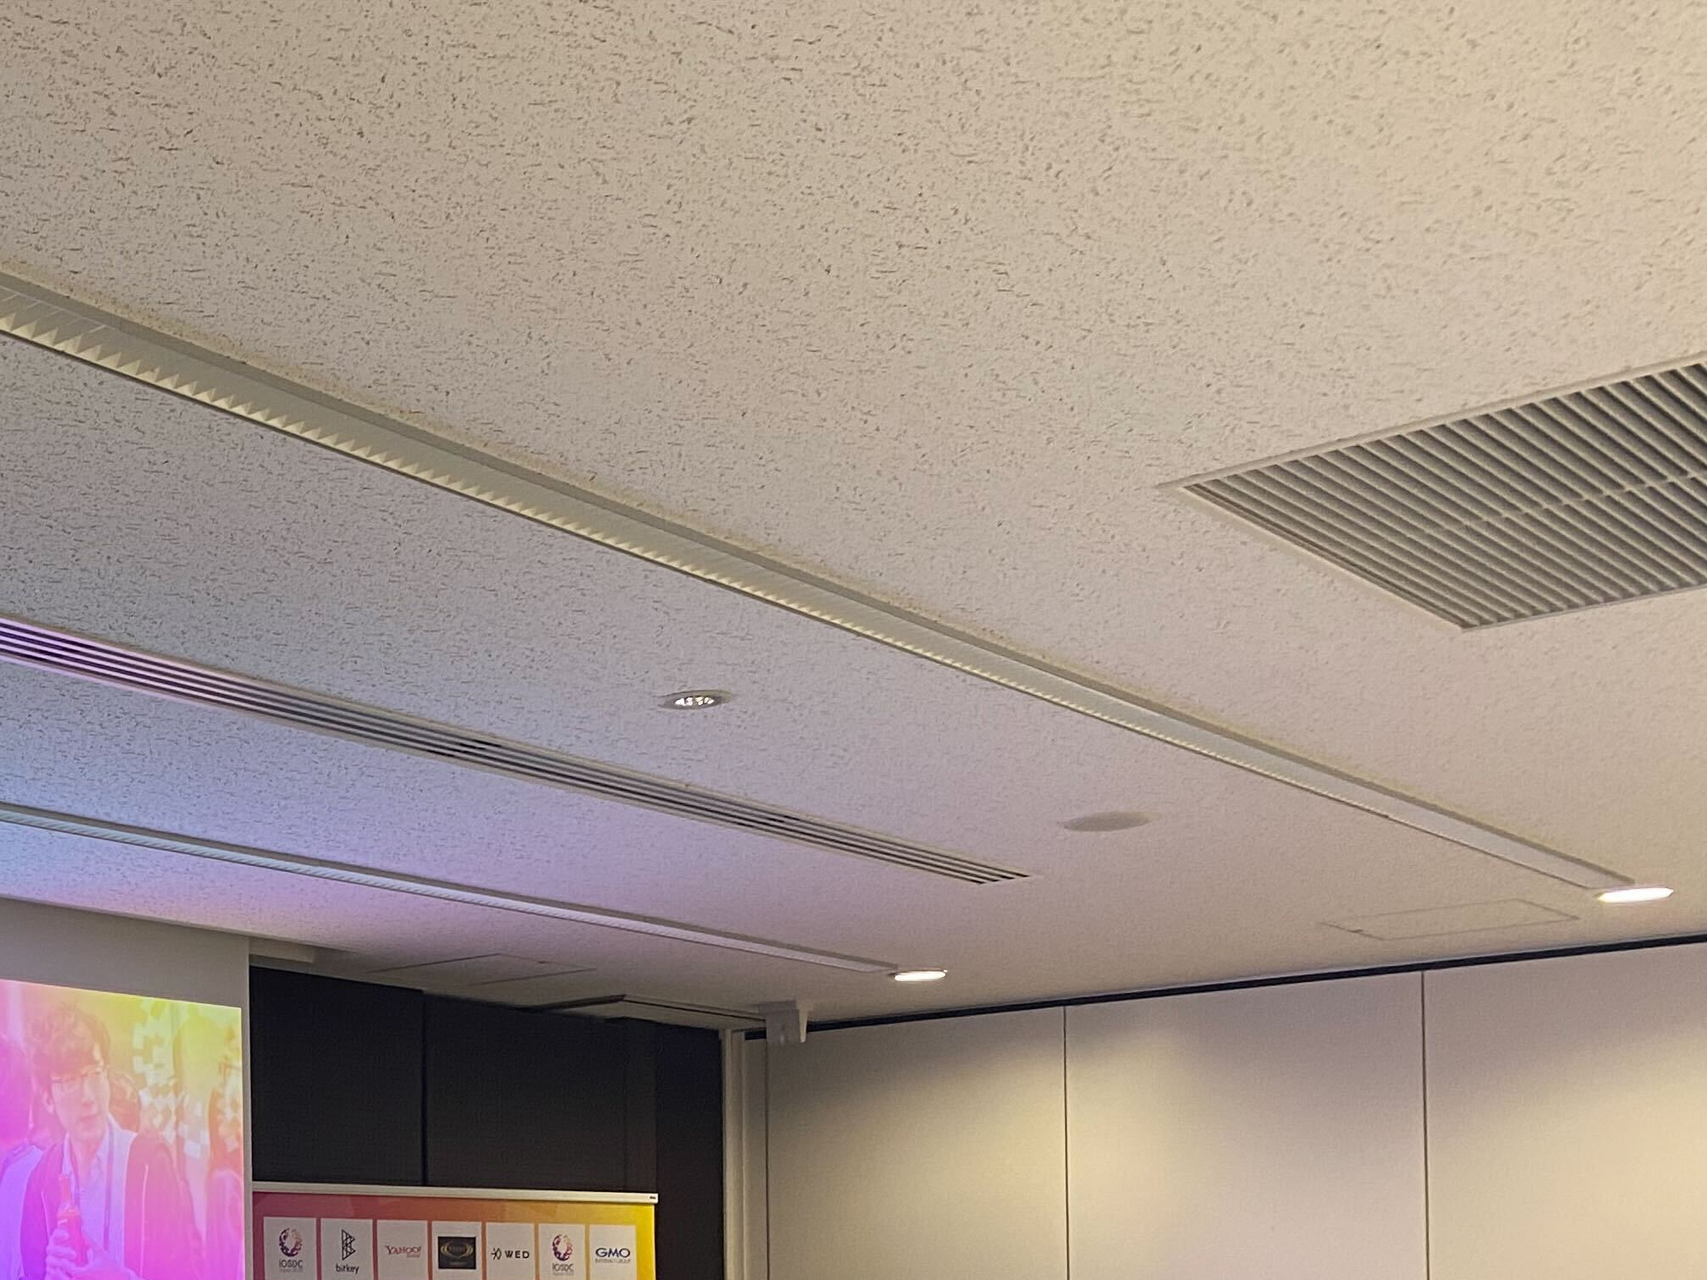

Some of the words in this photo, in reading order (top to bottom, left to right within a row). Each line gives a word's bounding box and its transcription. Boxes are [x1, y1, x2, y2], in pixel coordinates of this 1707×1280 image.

[505, 1250, 530, 1259] WED
[595, 1247, 631, 1258] GMO
[335, 1263, 360, 1274] bitkey
